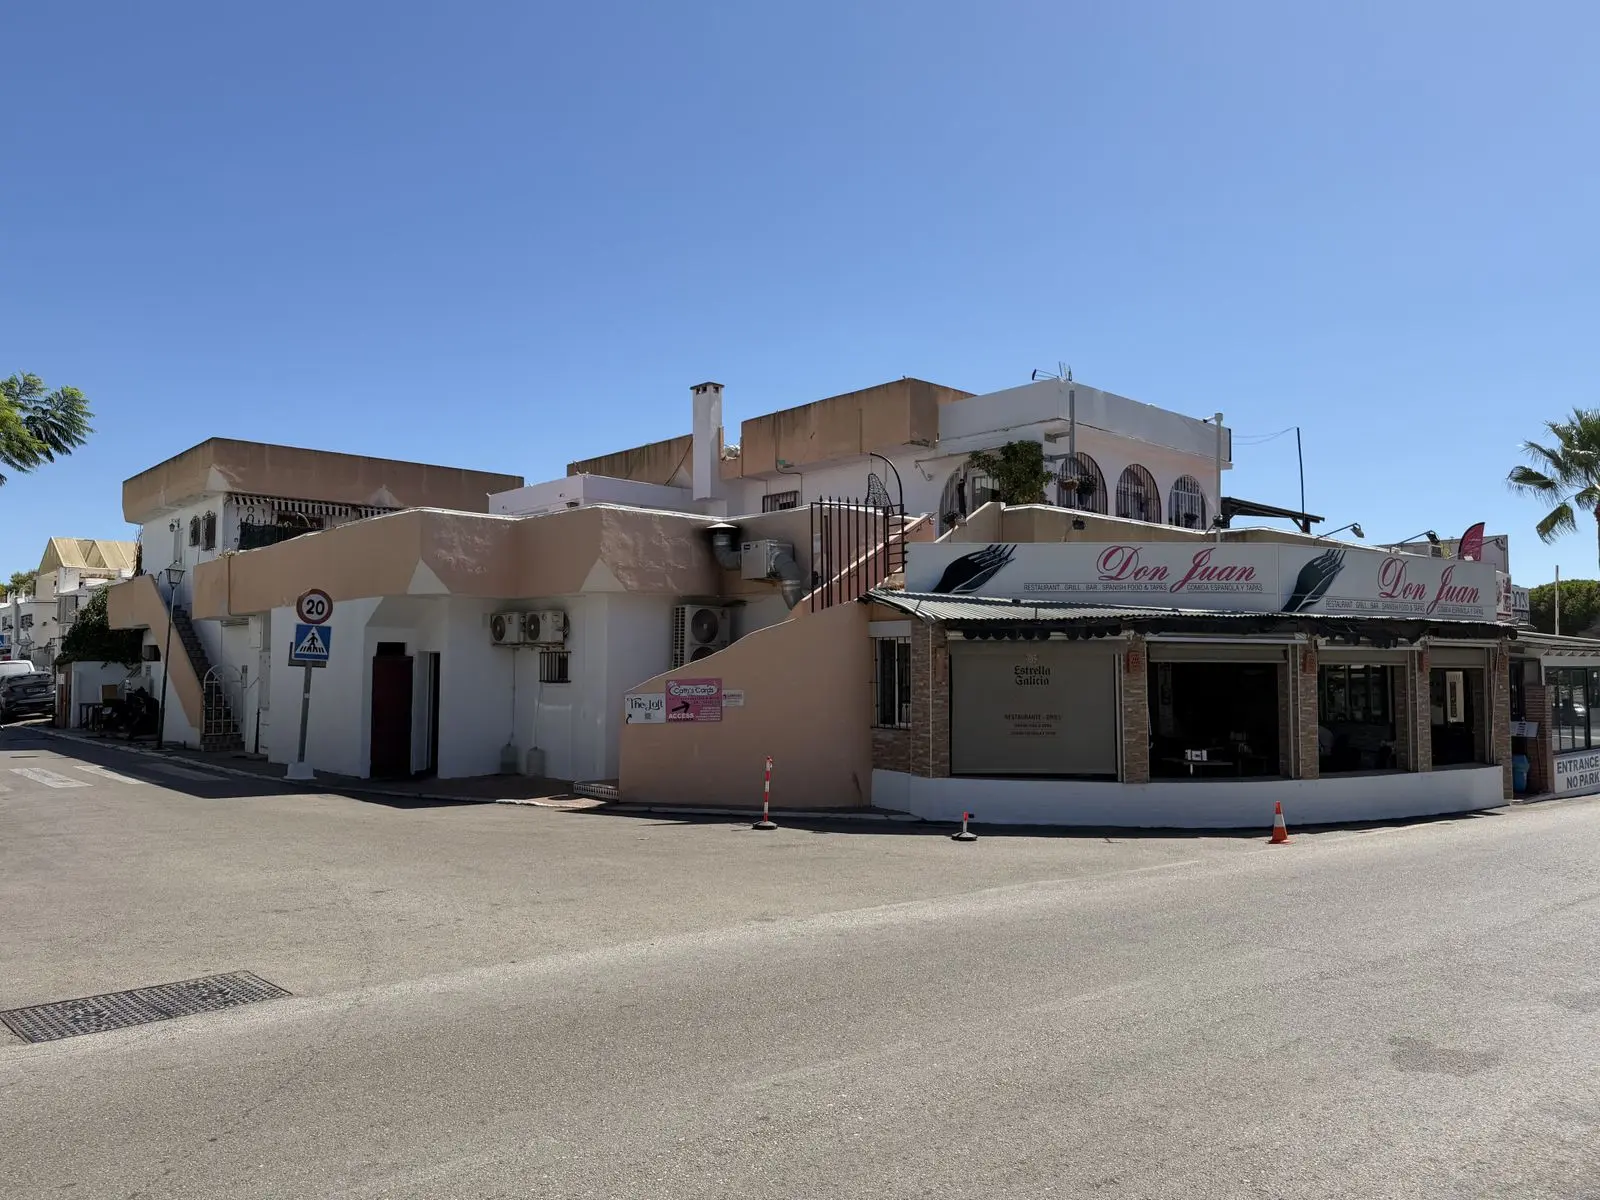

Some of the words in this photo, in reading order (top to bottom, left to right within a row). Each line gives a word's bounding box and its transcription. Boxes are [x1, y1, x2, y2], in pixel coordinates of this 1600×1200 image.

[1096, 545, 1170, 582] Don
[1169, 547, 1256, 594] Juan
[1024, 583, 1060, 591] RESTAURANT
[1246, 584, 1263, 592] TAPAS
[1377, 556, 1427, 600] Don
[1426, 564, 1480, 615] Juan
[306, 599, 325, 616] 20
[1014, 665, 1051, 676] Estrella
[1015, 675, 1050, 686] Galicia
[627, 697, 646, 709] The
[645, 699, 664, 712] Loft
[1556, 756, 1600, 774] ENTRANCE
[1566, 775, 1578, 789] NO
